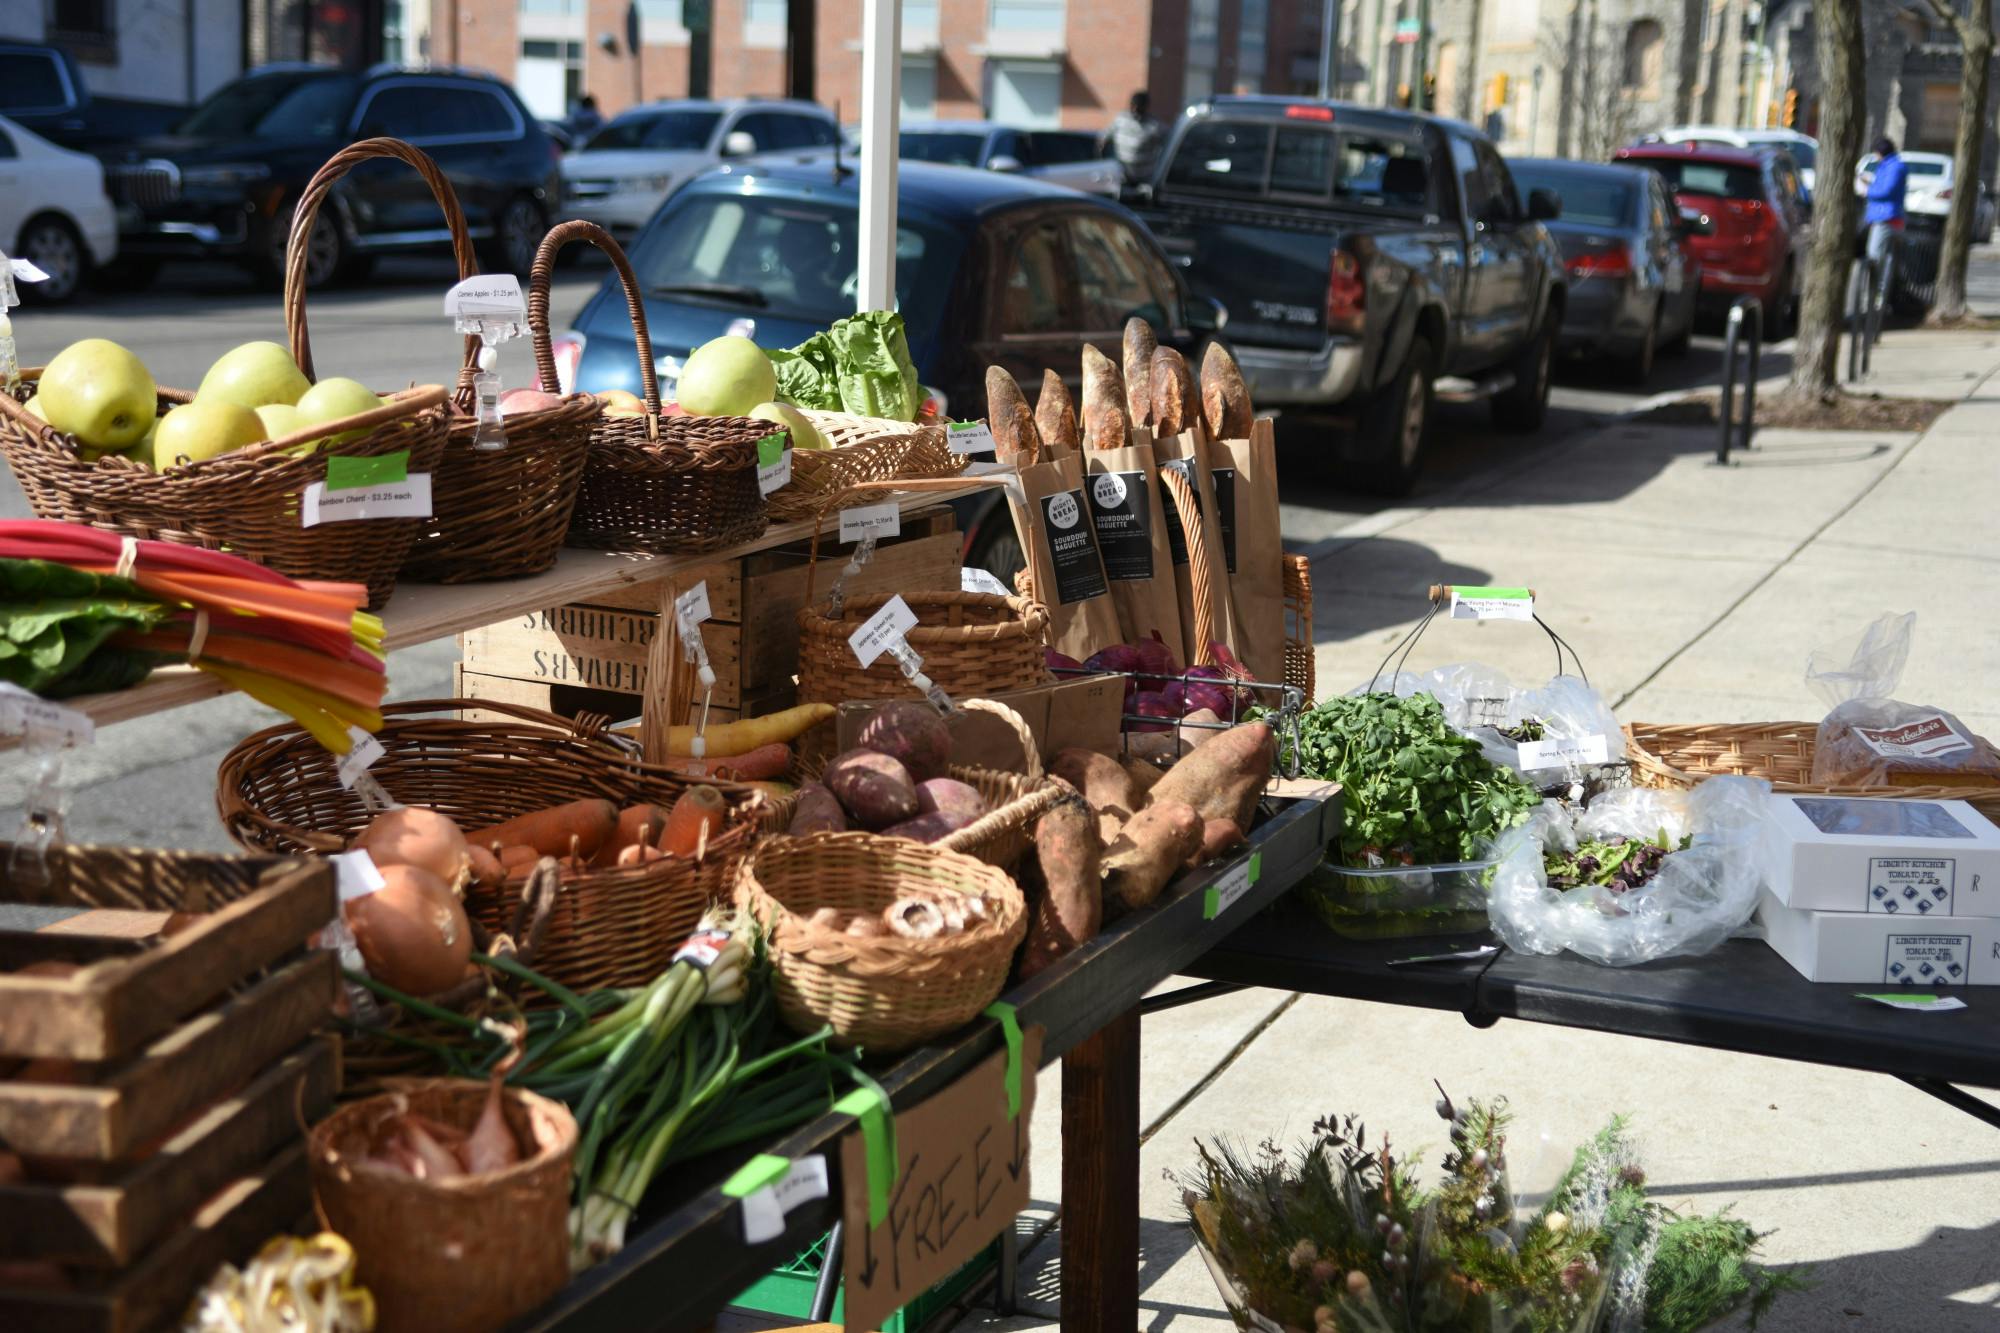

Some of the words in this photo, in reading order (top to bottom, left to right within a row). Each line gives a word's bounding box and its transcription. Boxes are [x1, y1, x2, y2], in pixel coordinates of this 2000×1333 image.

[345, 495, 366, 503] Chard
[371, 492, 393, 502] $3.25
[394, 492, 413, 500] each
[1097, 486, 1123, 498] BREAD
[1052, 498, 1073, 512] MIGHTY
[1052, 503, 1077, 520] BREAD
[1097, 521, 1128, 529] BAGUETTE
[1055, 538, 1086, 552] BAGUETTE
[523, 608, 655, 646] RCHARDS
[1878, 860, 1911, 868] LIBERTY
[1911, 860, 1946, 869] KITCHEN
[1895, 937, 1928, 945] LIBERTY
[1905, 947, 1937, 955] TOMATO
[890, 1125, 1002, 1291] FREE
